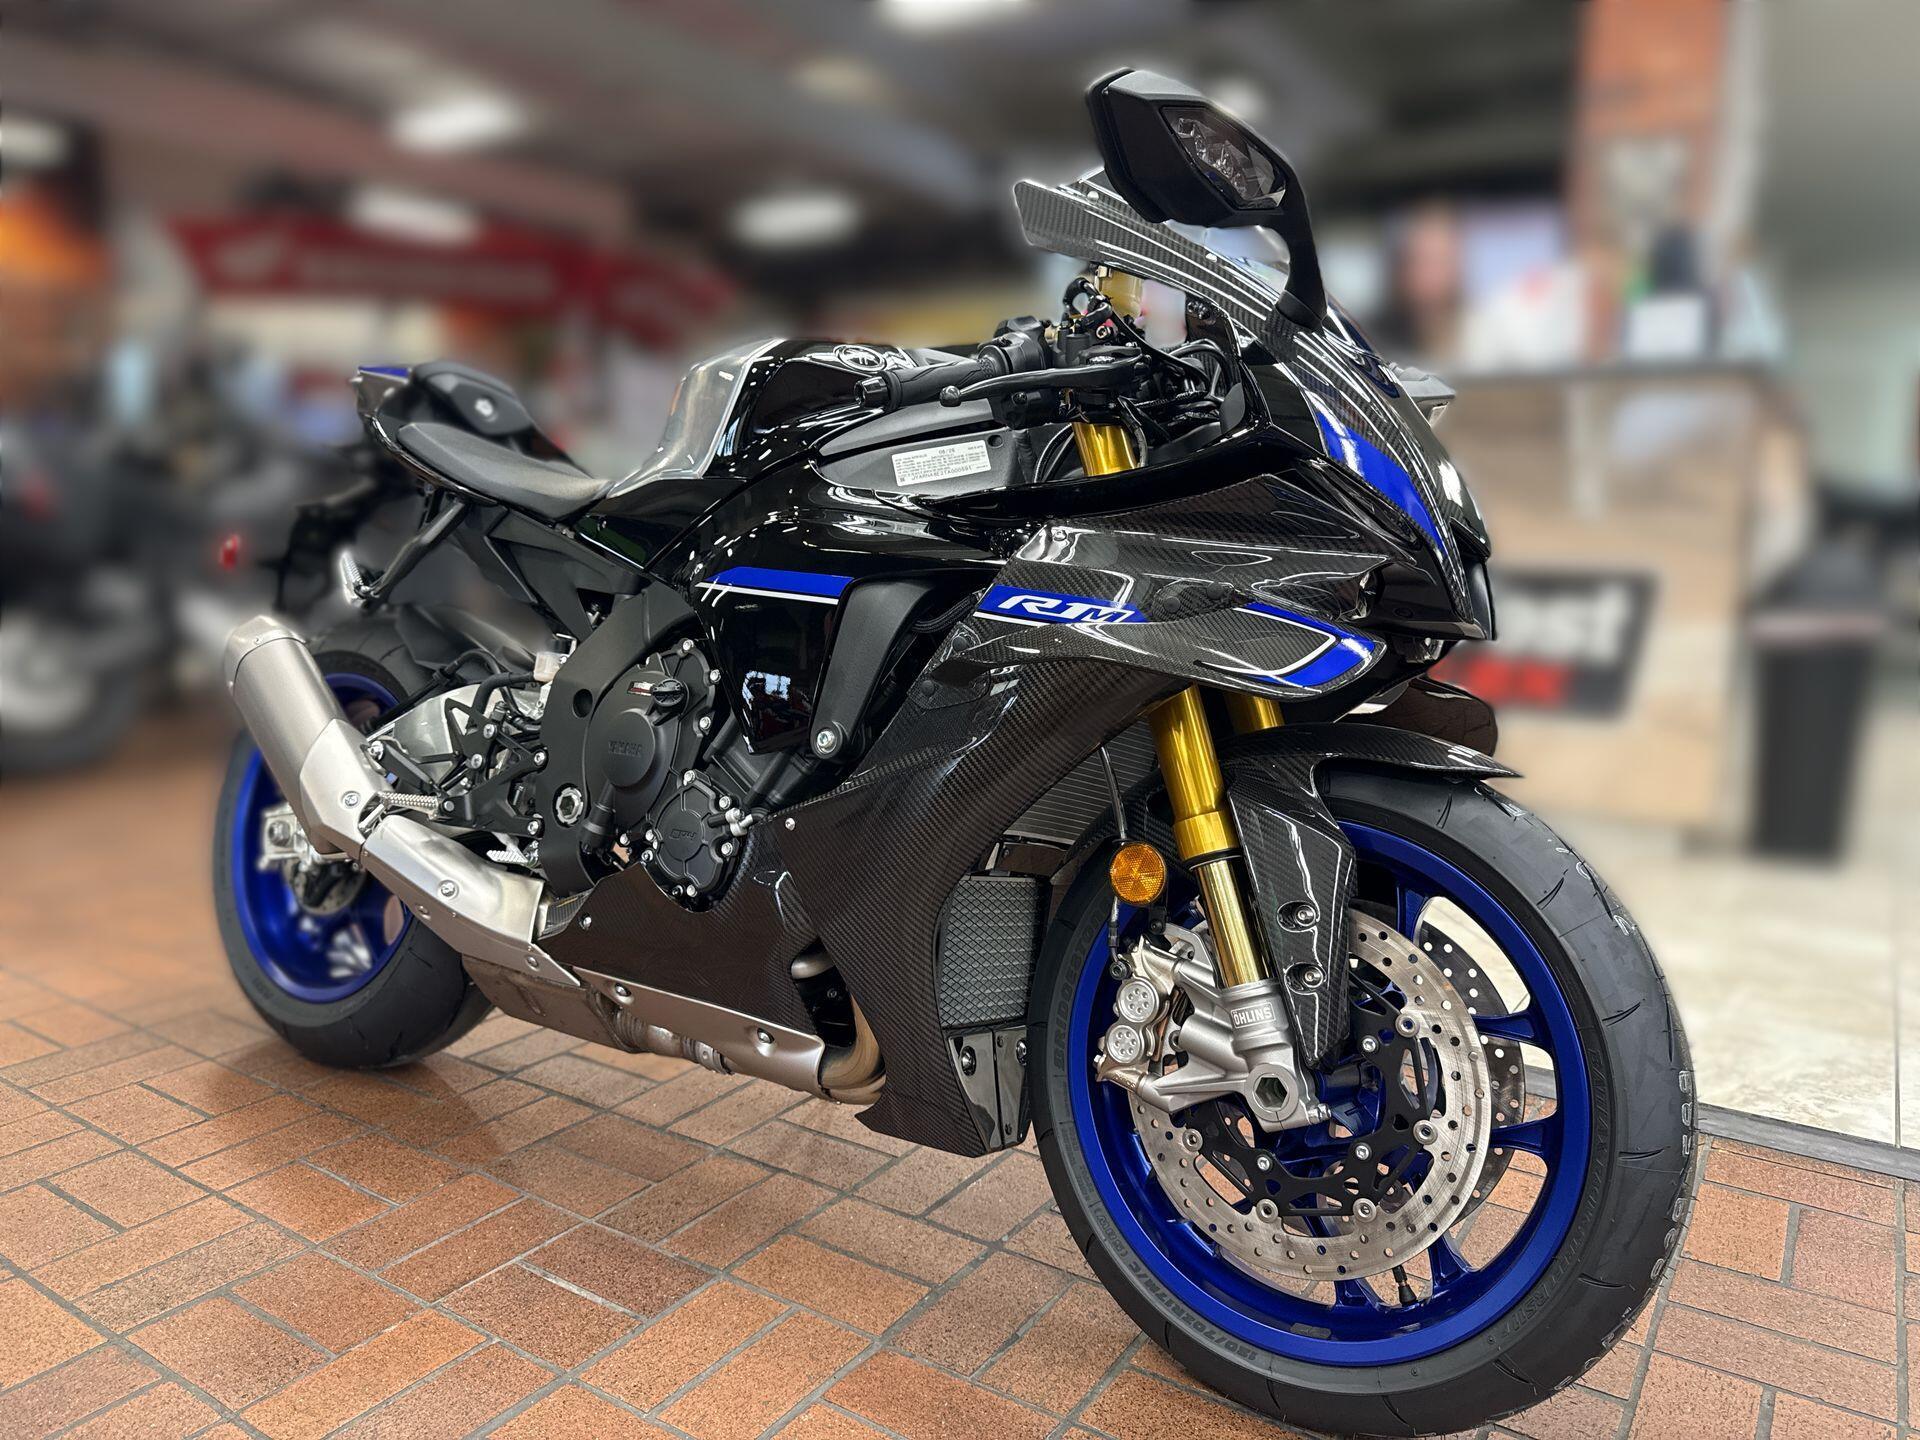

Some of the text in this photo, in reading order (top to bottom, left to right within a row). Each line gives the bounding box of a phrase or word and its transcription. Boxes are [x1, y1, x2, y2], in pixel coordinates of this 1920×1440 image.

[998, 595, 1135, 623] R1M
[608, 741, 642, 757] YAMAHA
[1053, 894, 1111, 1071] BRIDGESTONE
[1233, 1007, 1272, 1026] ÖHLINS
